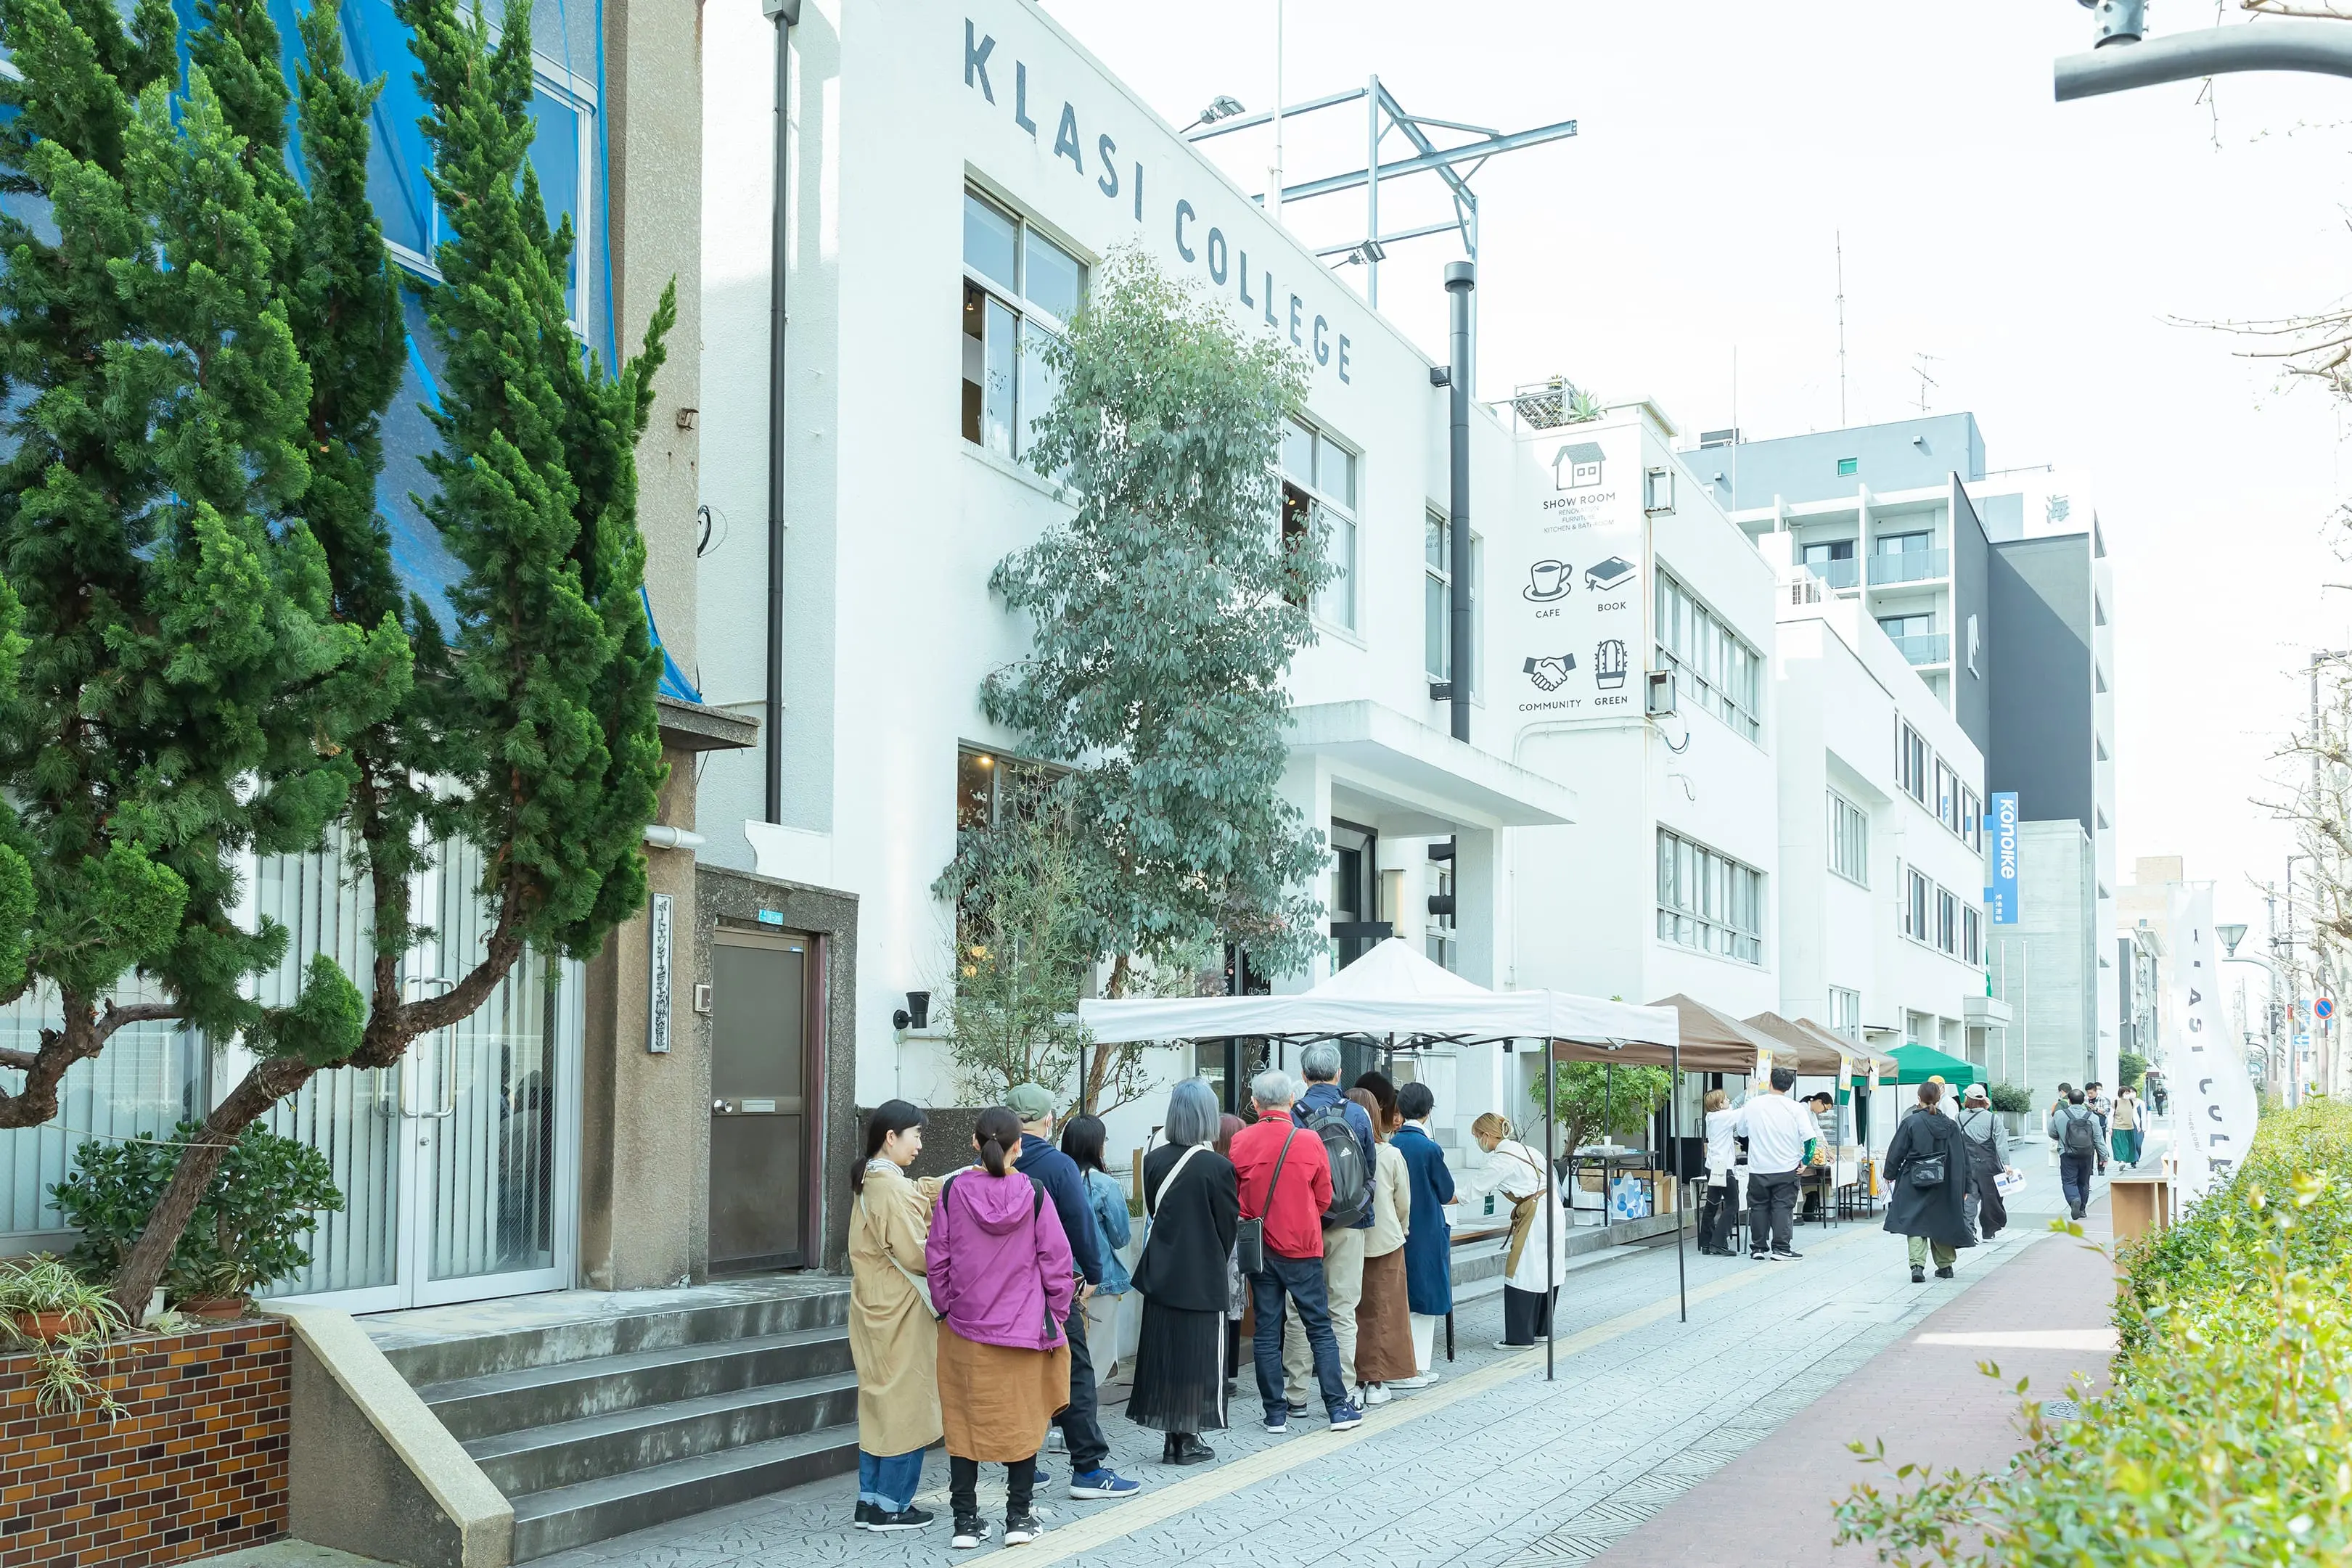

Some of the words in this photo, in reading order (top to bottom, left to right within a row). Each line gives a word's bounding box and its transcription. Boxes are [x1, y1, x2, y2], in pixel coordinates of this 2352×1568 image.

[964, 17, 1144, 223] KLASI
[1175, 198, 1351, 386] COLLEGE
[1543, 497, 1576, 509] SHOW
[1580, 493, 1615, 505] ROOM
[1558, 506, 1599, 516] RENOVAN
[1562, 514, 1595, 523] FURNITUE
[1544, 525, 1570, 534] KITCHEN
[1597, 602, 1626, 612] BOOK
[1536, 609, 1561, 618] CAFE
[1519, 699, 1581, 712] COMMUNITY
[1594, 696, 1628, 705] GREEN
[1099, 1479, 1115, 1490] N
